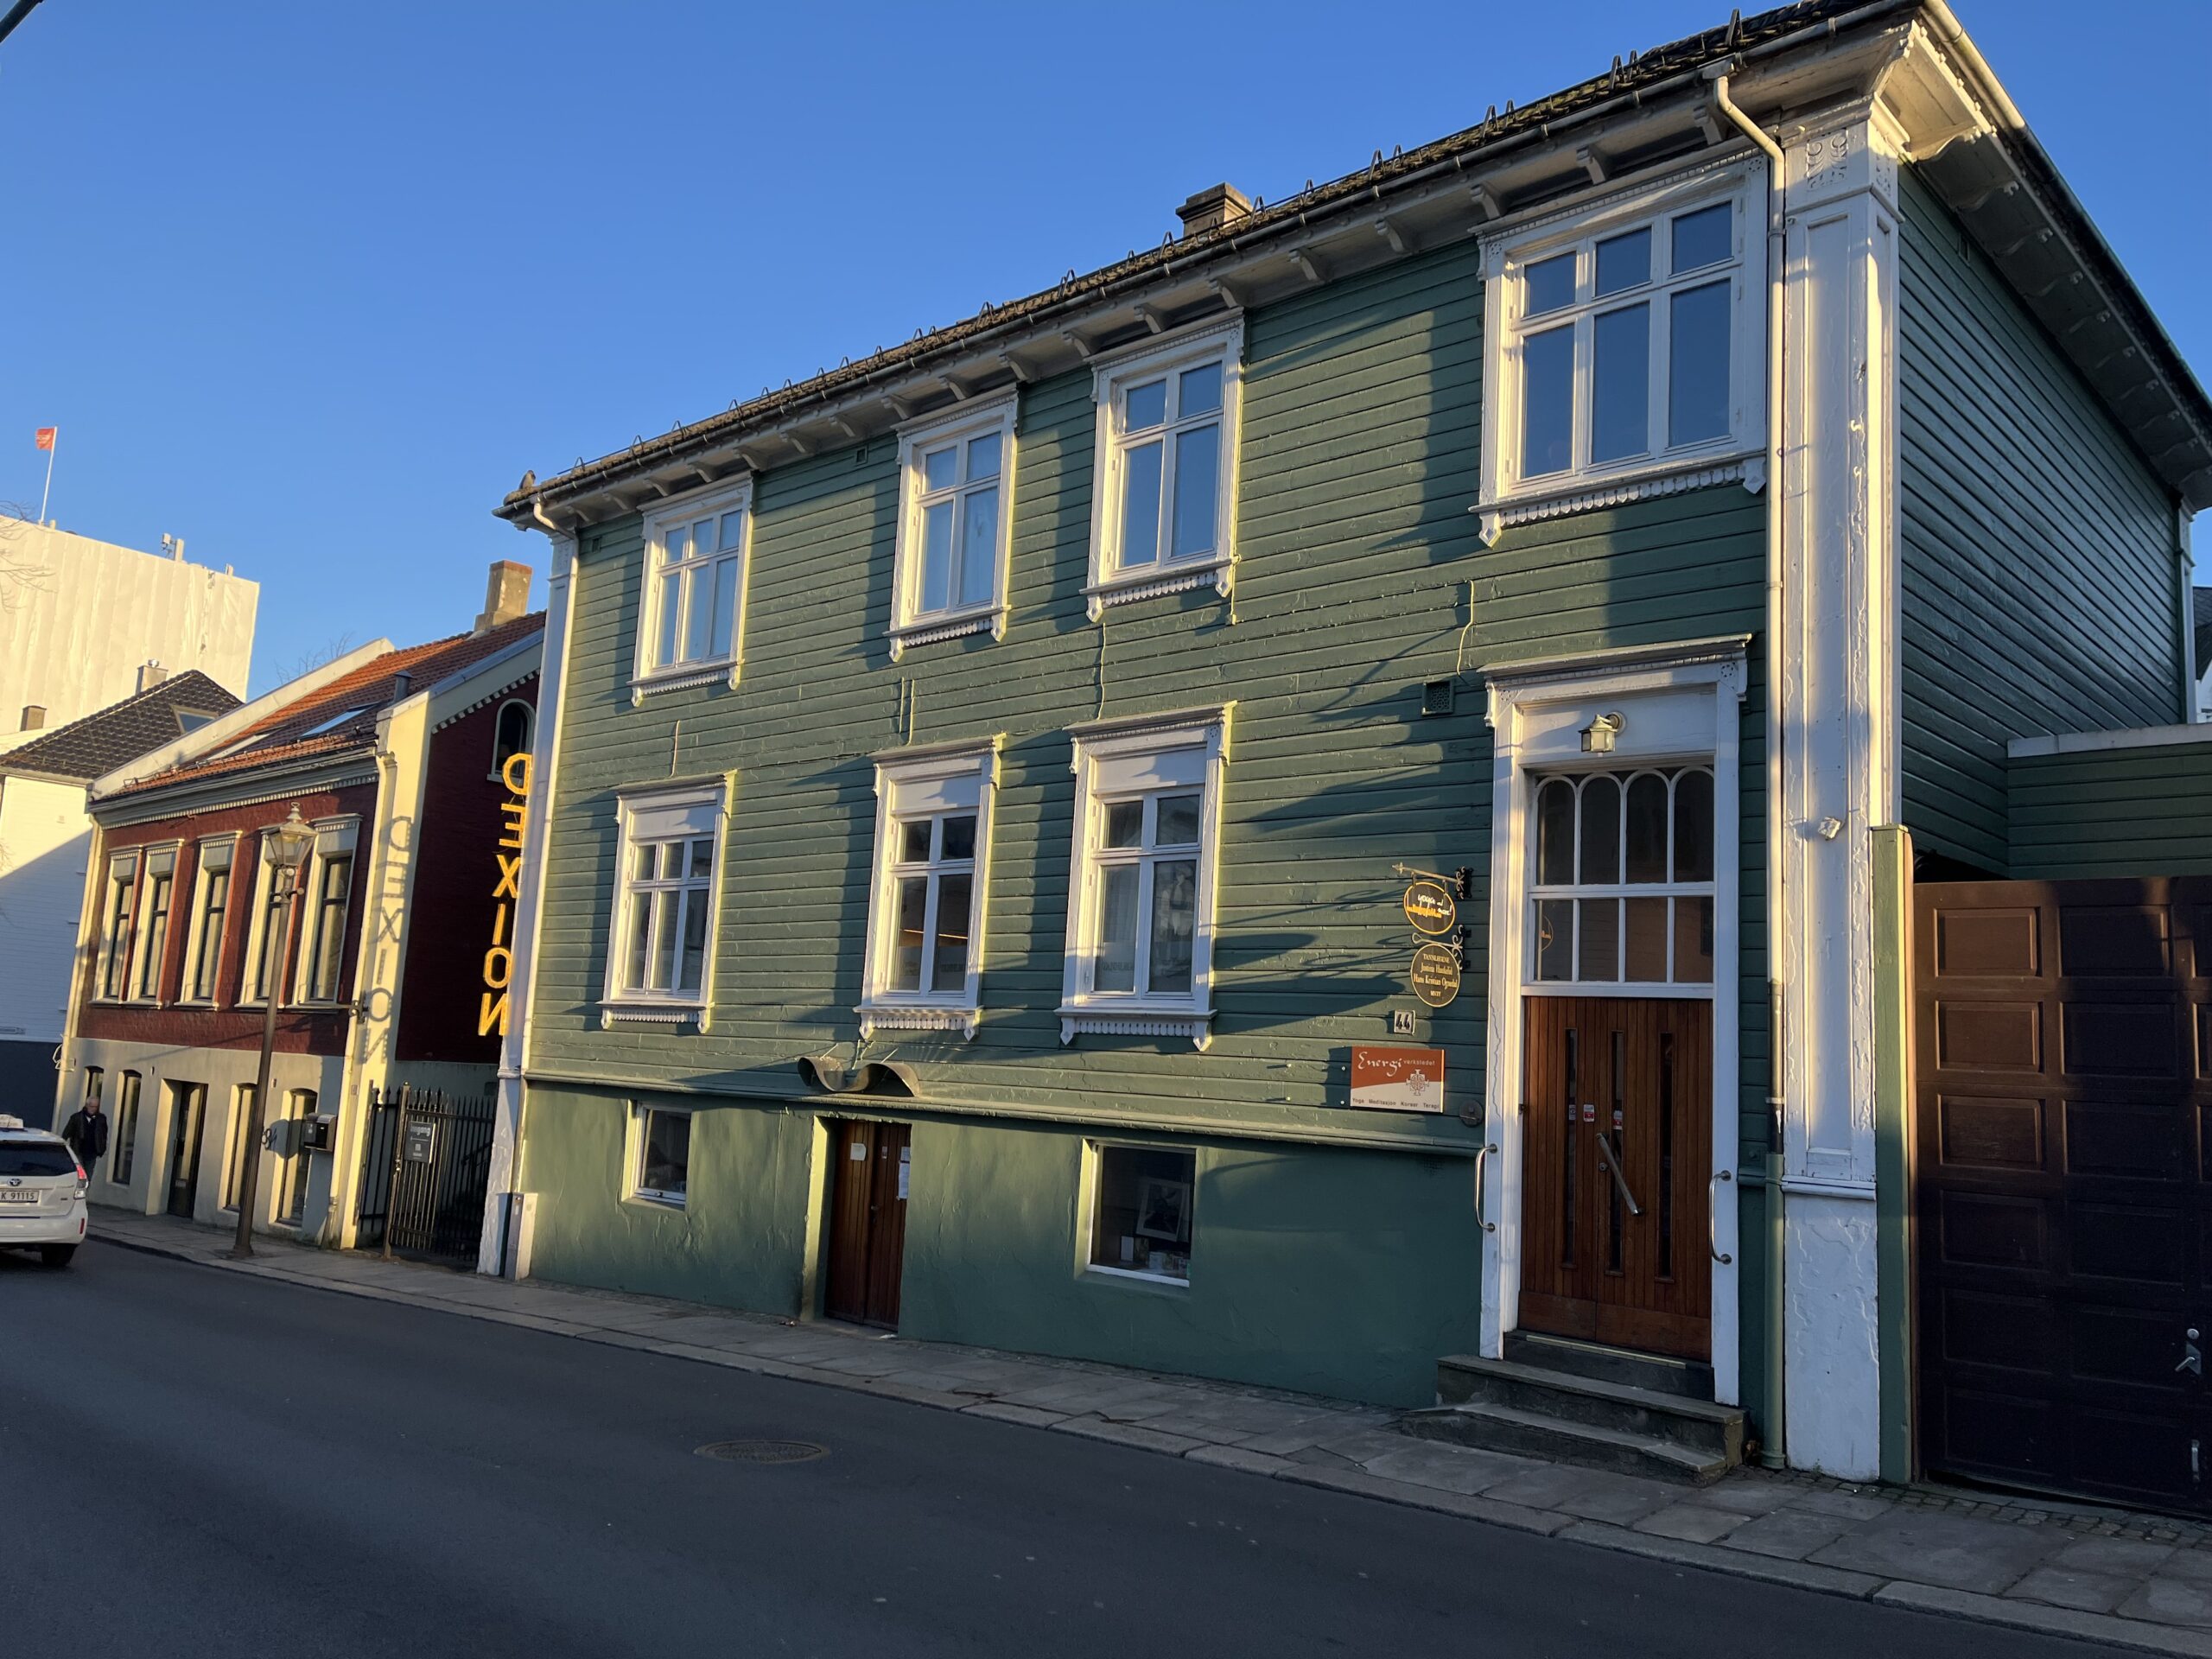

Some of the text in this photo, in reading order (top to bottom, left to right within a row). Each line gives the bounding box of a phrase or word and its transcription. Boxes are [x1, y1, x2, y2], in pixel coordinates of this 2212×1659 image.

[1396, 1014, 1410, 1030] 44
[1357, 1052, 1402, 1077] Energi
[10, 1192, 35, 1200] 91115
